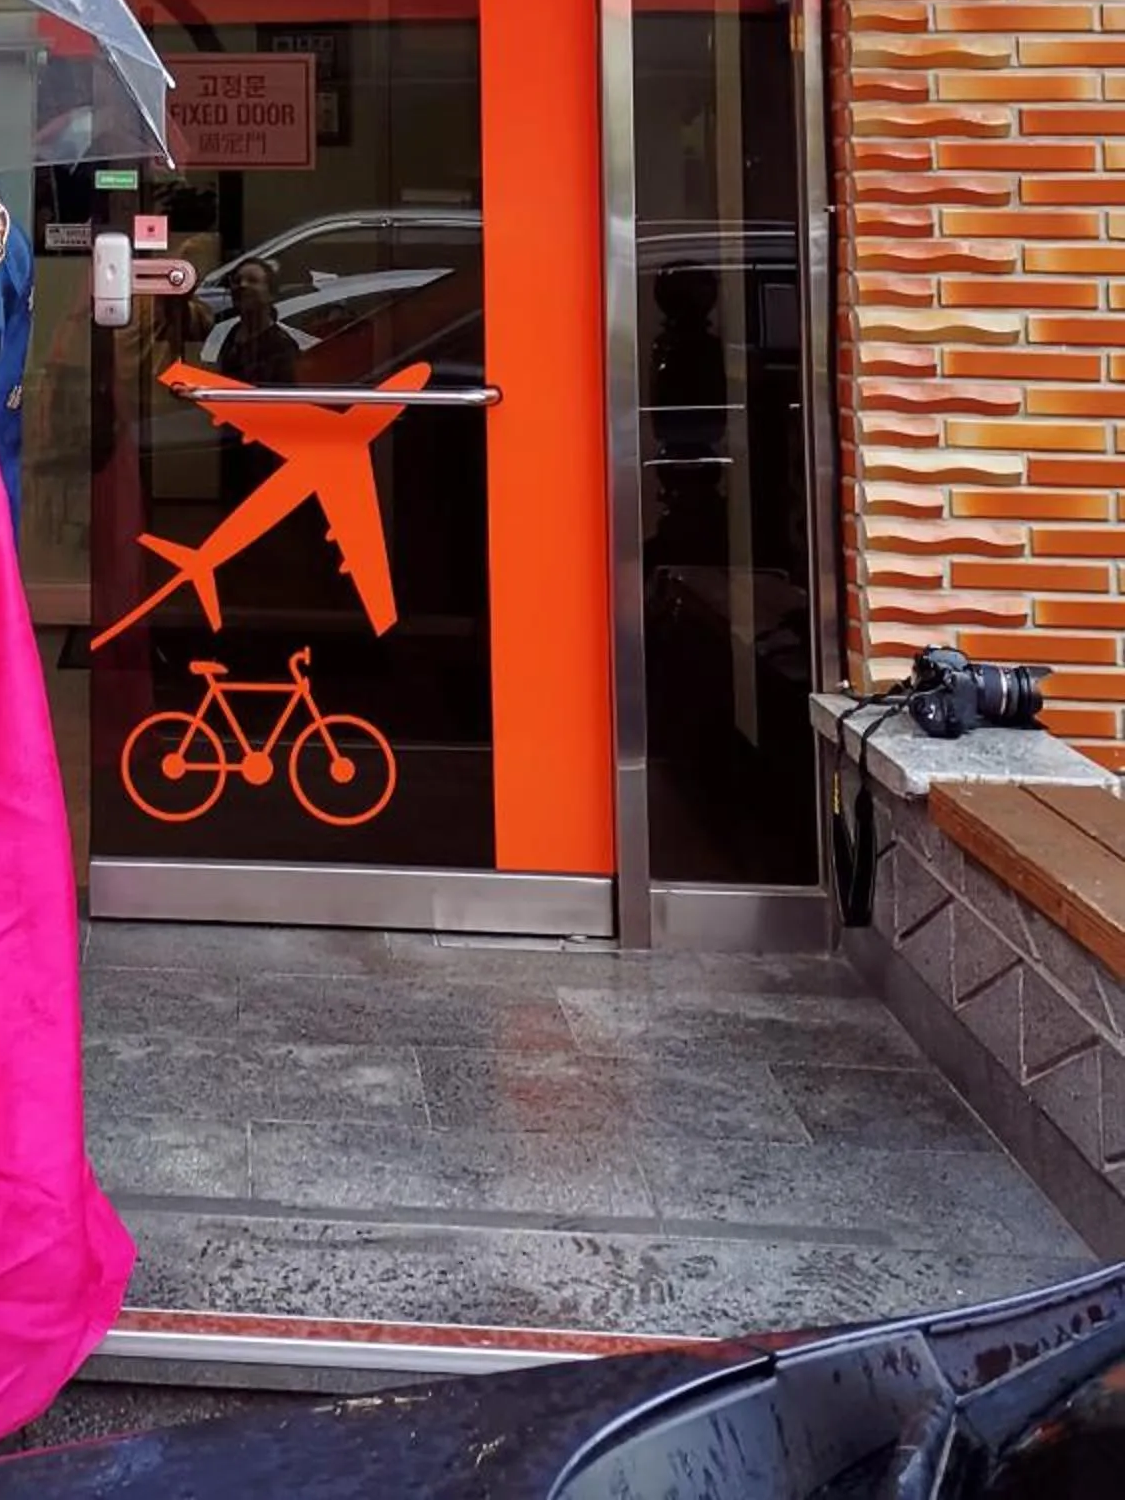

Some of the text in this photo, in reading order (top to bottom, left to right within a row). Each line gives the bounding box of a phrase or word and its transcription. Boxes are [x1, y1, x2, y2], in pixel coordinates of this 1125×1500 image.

[196, 73, 266, 99] 고정문
[169, 102, 295, 127] FIXED DOOR
